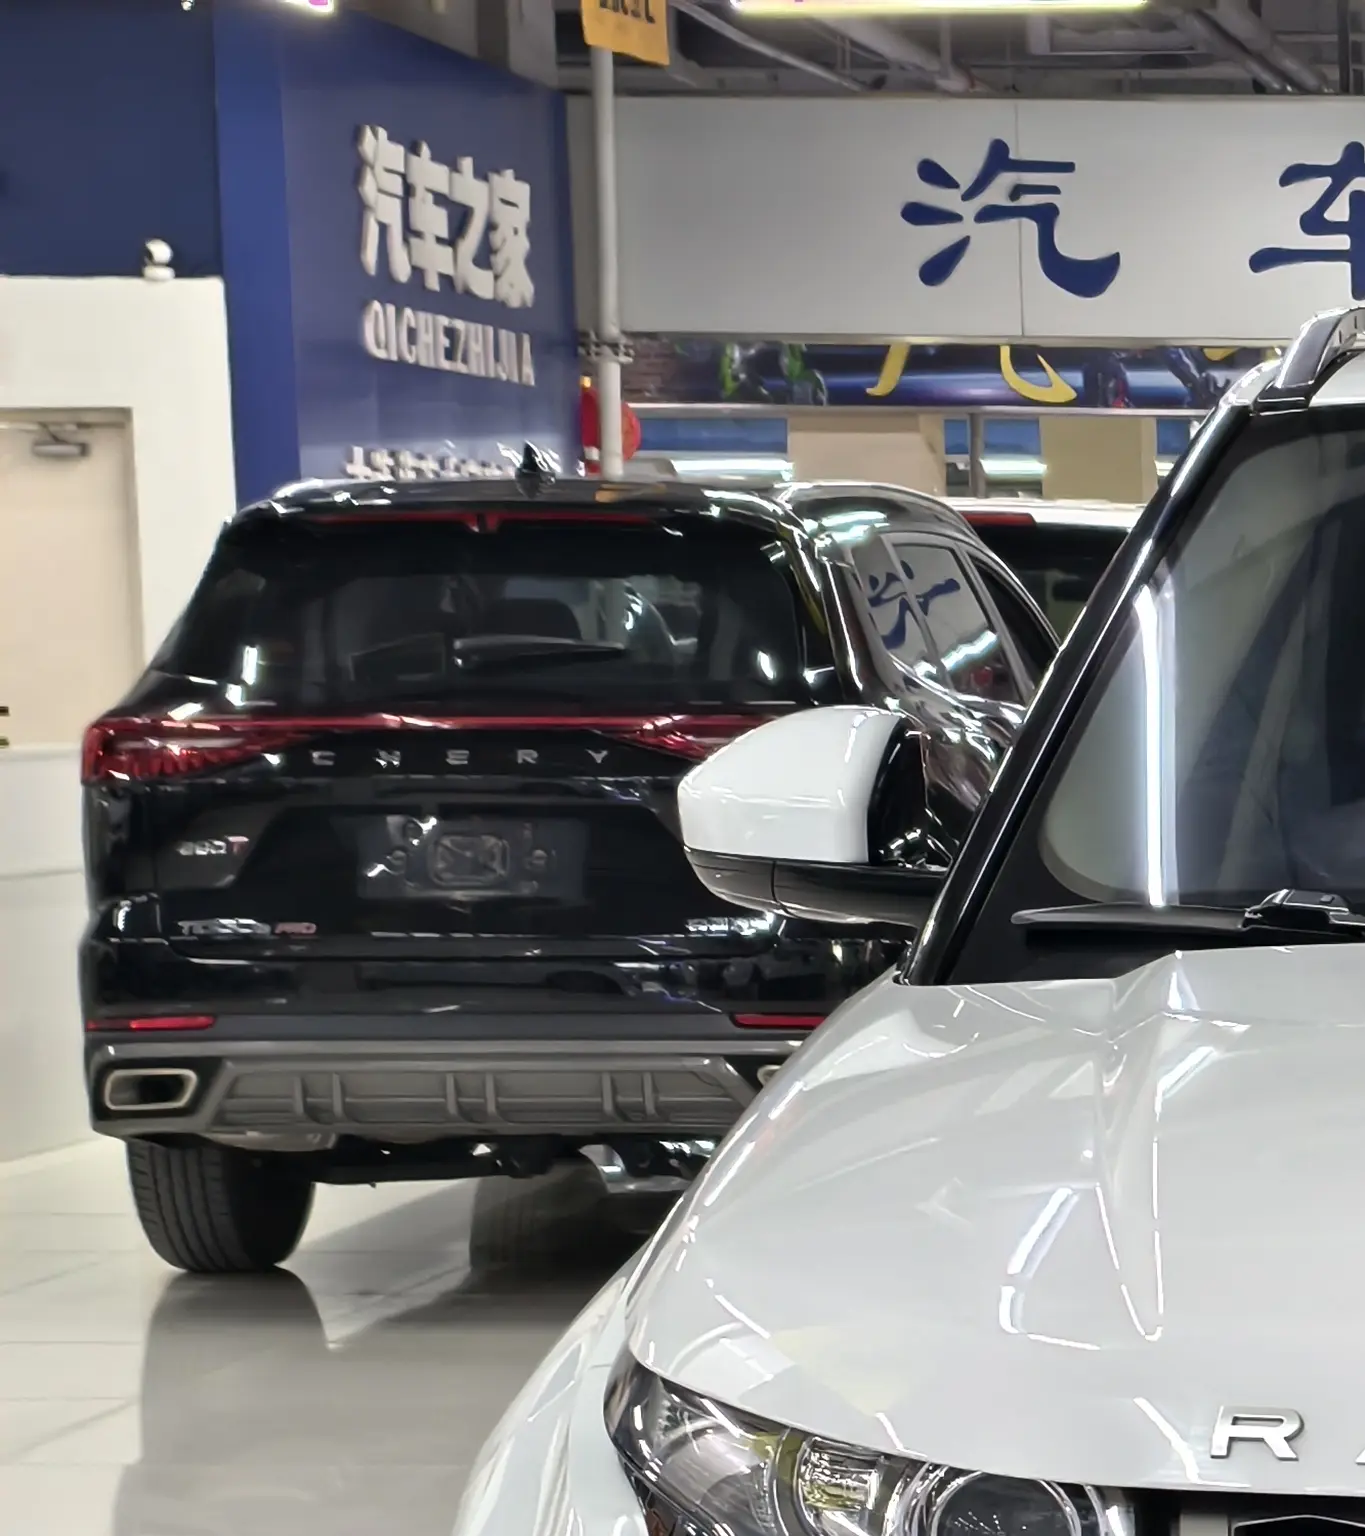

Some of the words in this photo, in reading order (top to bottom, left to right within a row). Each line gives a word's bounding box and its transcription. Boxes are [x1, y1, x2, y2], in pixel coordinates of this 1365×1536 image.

[357, 124, 535, 308] 汽车之家
[310, 749, 609, 768] CHERY
